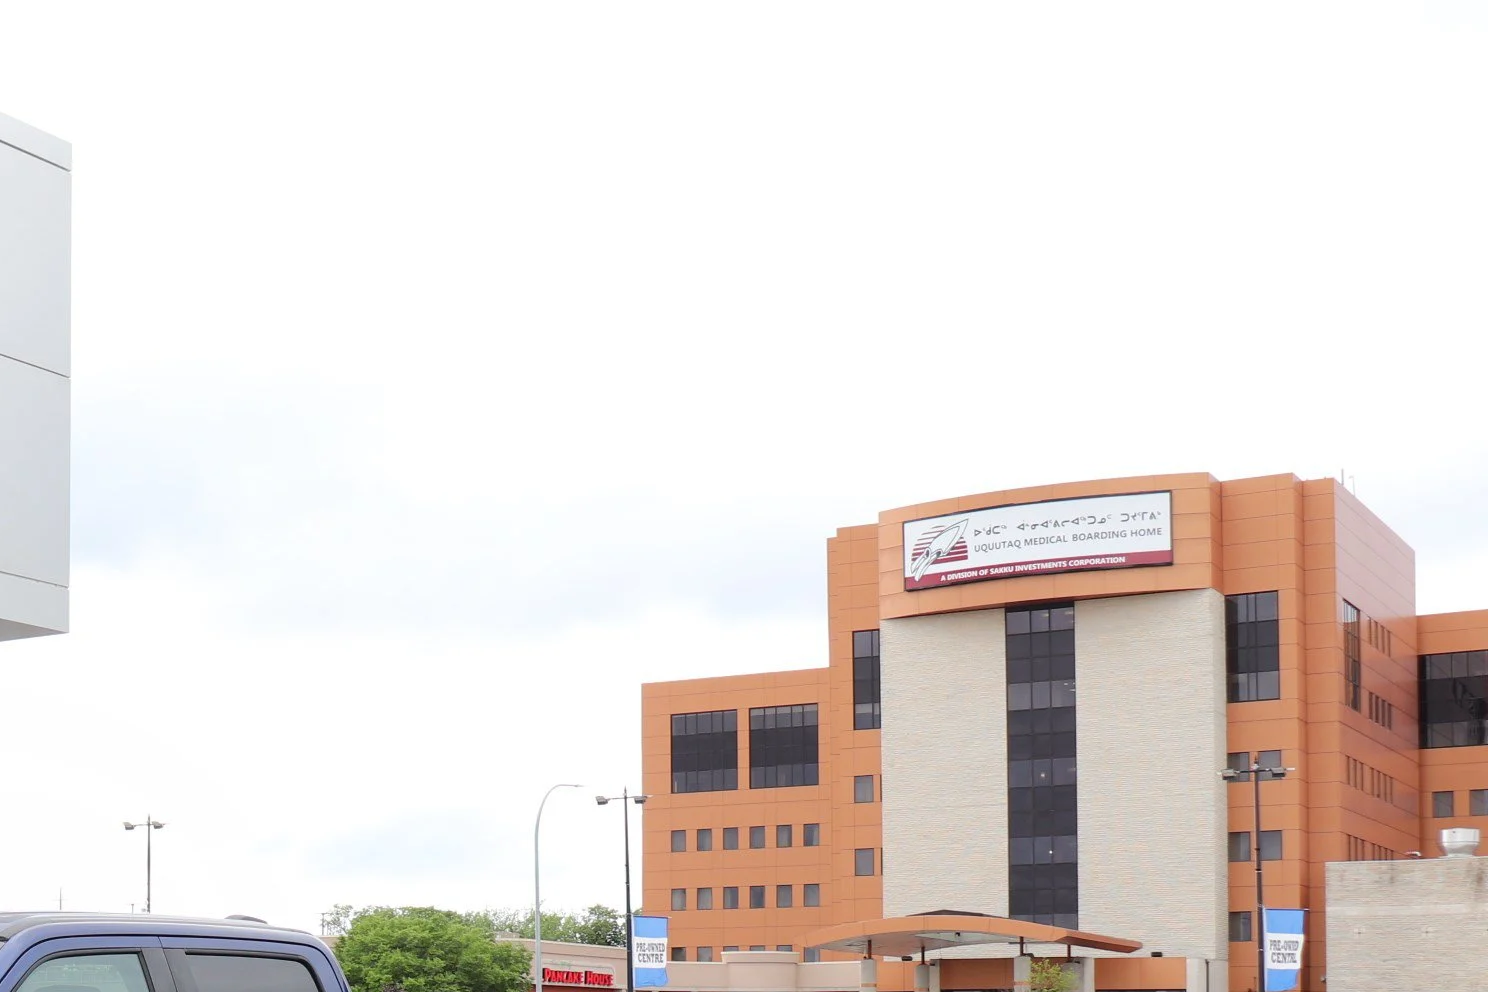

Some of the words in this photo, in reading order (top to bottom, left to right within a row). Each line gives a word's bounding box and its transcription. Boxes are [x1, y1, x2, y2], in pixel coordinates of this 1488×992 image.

[974, 539, 1022, 553] UQUUTAQ
[1023, 535, 1068, 547] MEDICAL
[1072, 529, 1128, 542] BOARDING
[1130, 527, 1163, 538] HOME
[940, 574, 947, 582] A
[947, 571, 978, 581] DIVISION
[979, 568, 989, 576] OF
[990, 565, 1014, 575] SAKKU
[1015, 560, 1068, 572] INVESTMENTS
[1068, 556, 1126, 567] CORPORATION
[638, 953, 664, 963] CENTRE
[543, 968, 583, 984] PANCAKE
[585, 971, 614, 986] HOUSE
